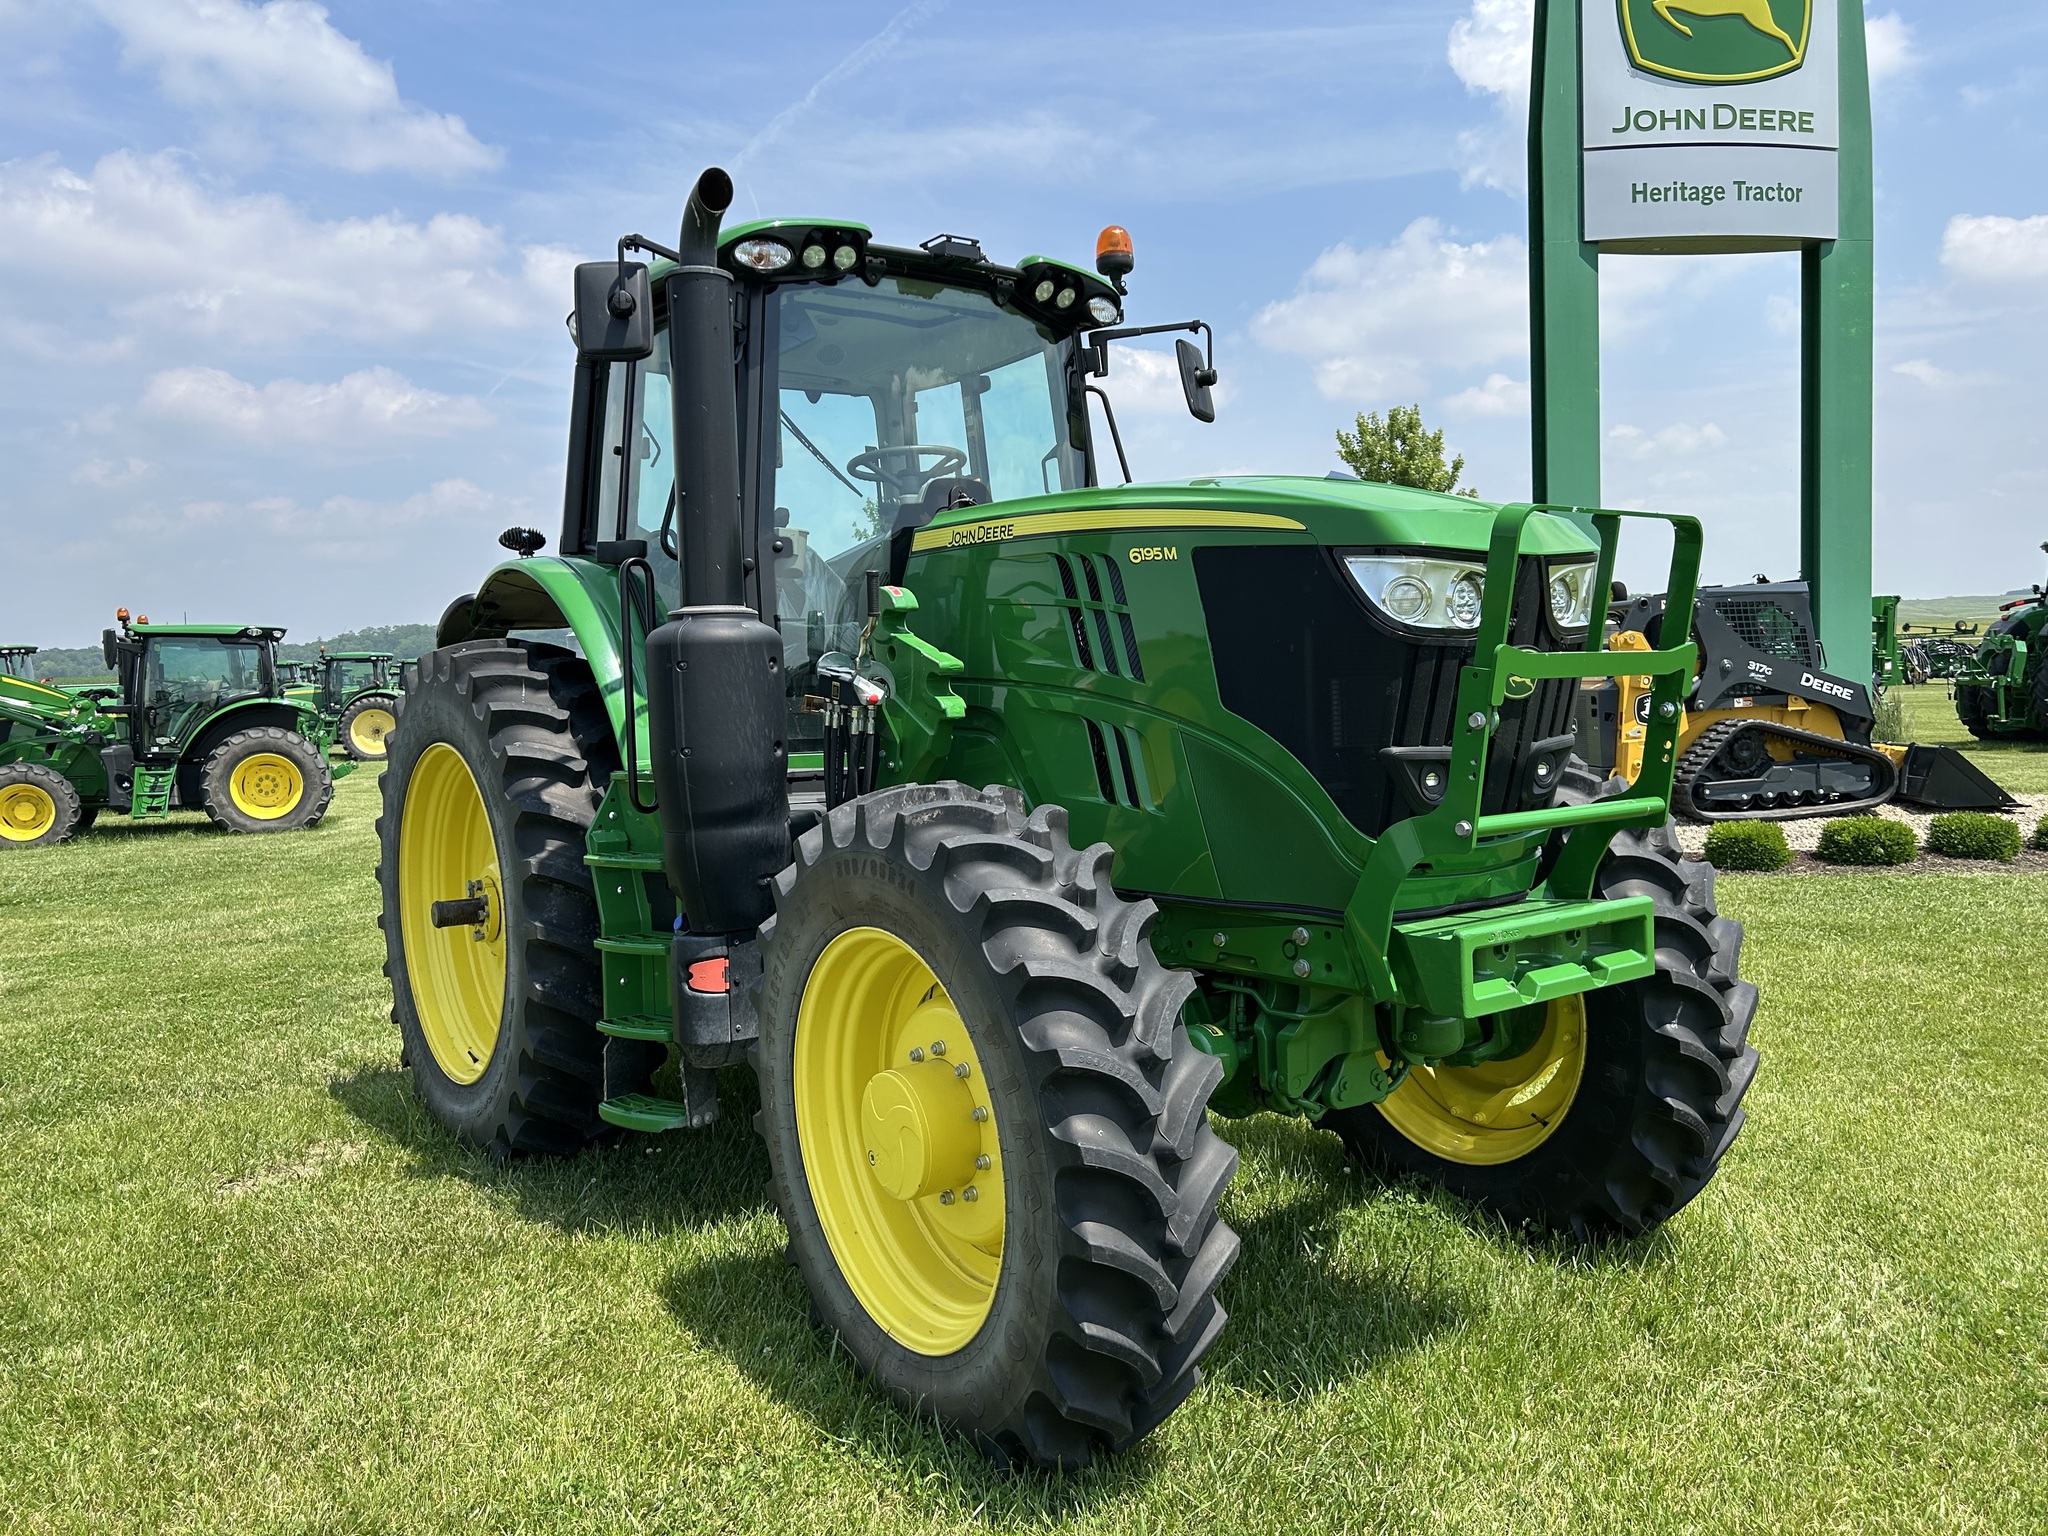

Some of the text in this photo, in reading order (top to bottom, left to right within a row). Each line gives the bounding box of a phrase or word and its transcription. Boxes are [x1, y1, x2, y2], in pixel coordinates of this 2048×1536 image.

[1612, 103, 1814, 133] JOHN DEERE
[1631, 180, 1803, 205] Heritage Tractor
[947, 525, 1014, 547] JOHN DEERE
[1747, 660, 1773, 675] 317G
[1800, 672, 1854, 700] DEERE
